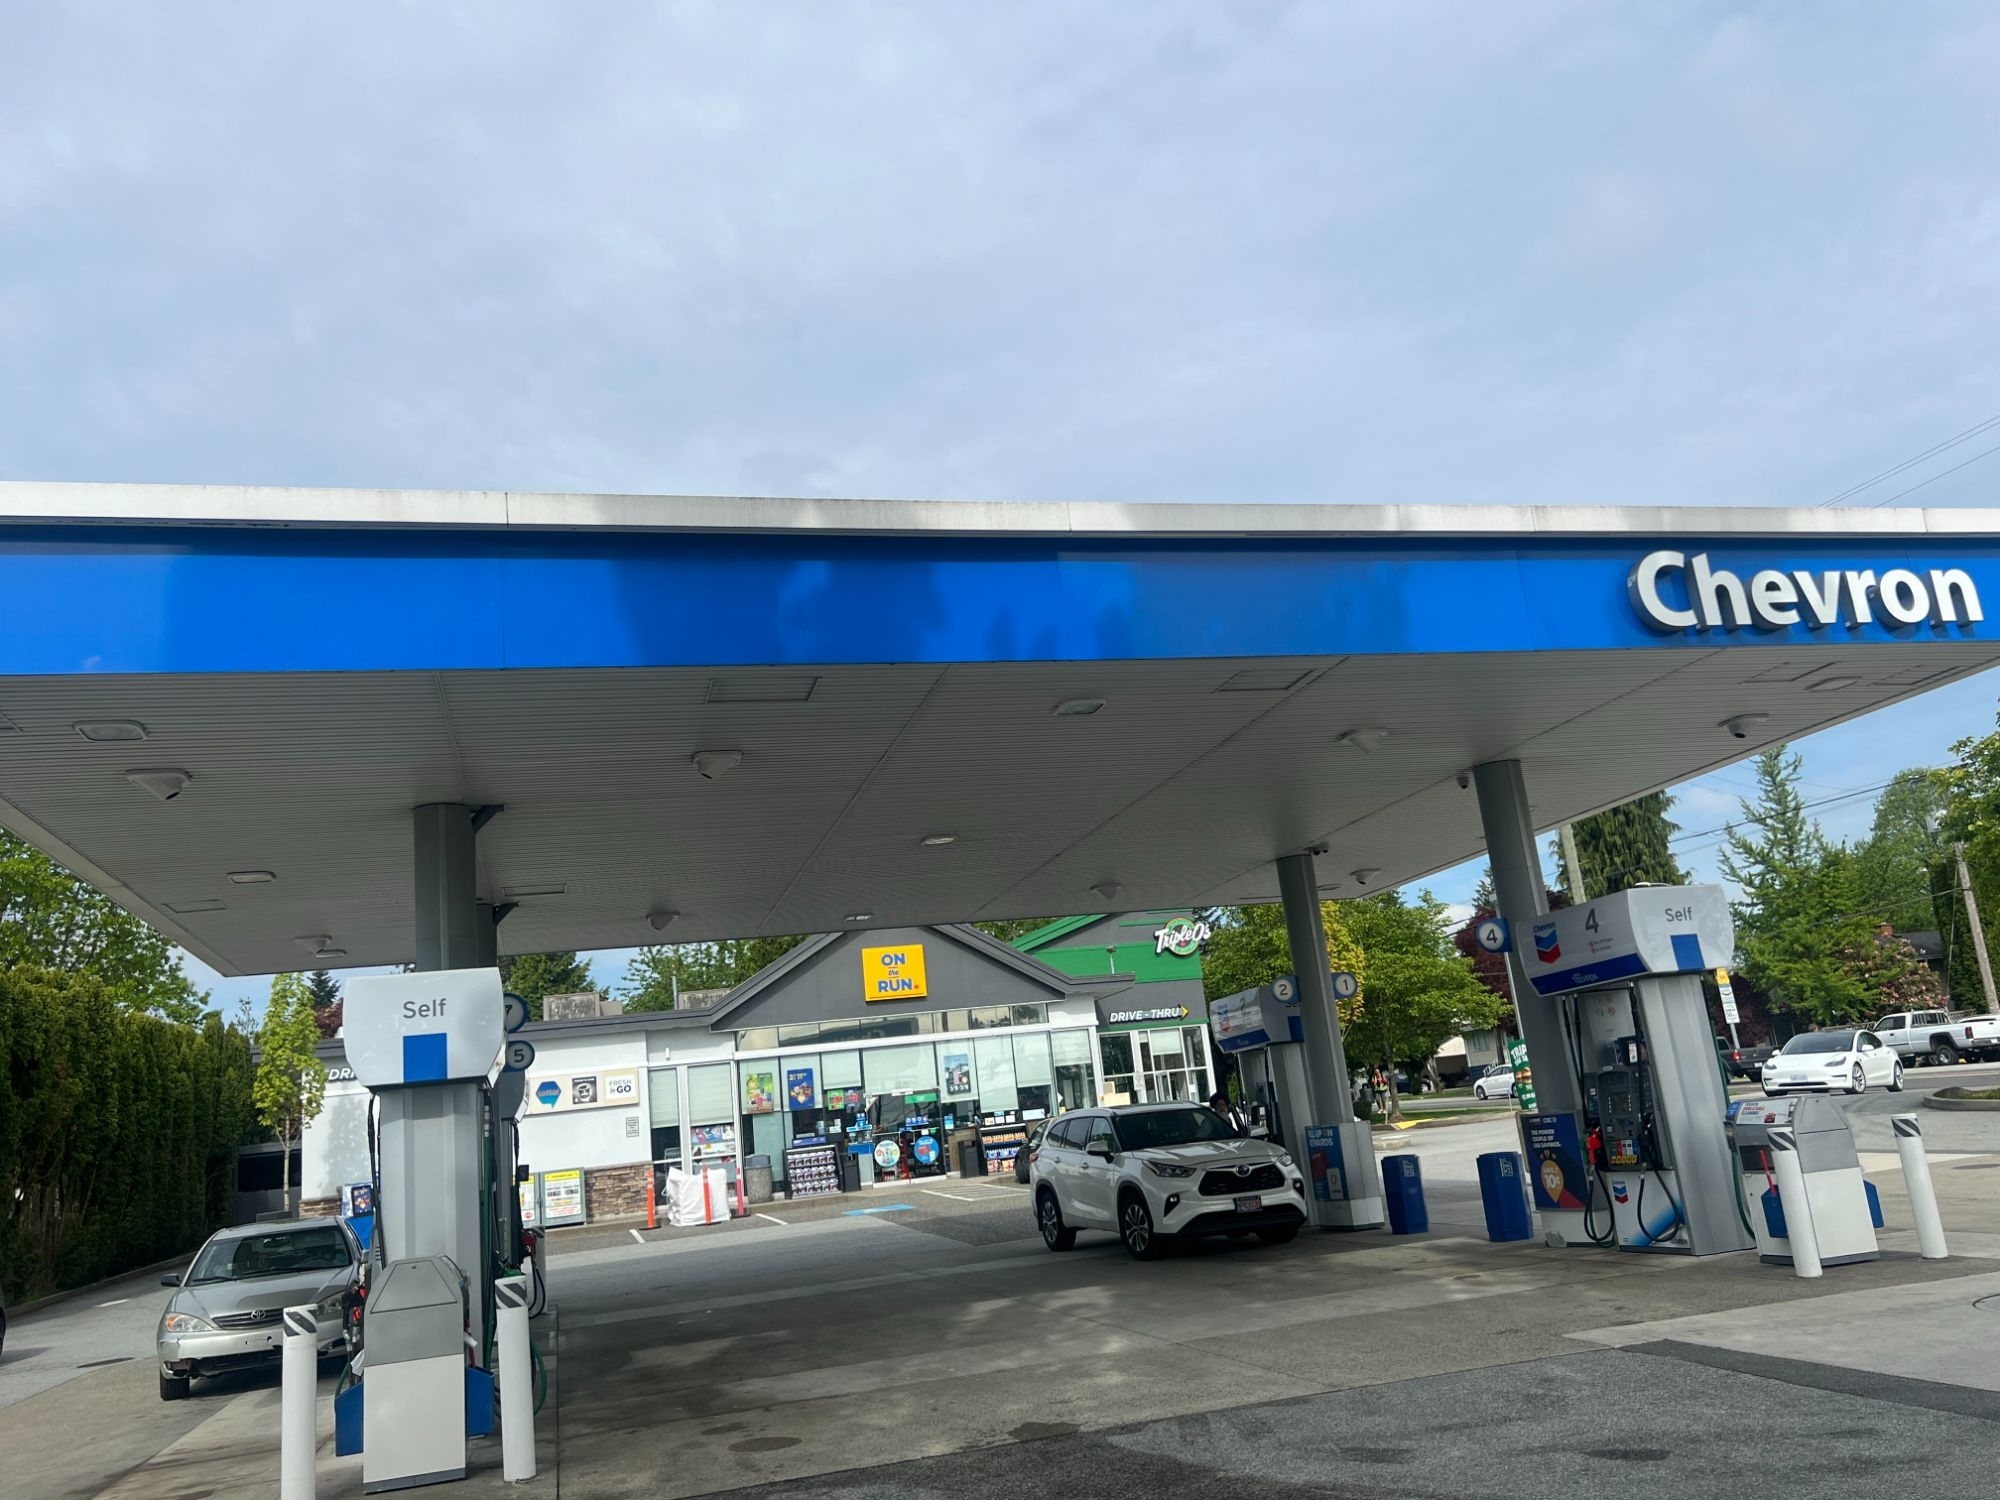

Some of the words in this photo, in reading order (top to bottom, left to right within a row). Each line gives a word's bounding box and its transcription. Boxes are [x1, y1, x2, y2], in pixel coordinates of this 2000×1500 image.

[1636, 550, 1984, 628] Chevron
[1585, 908, 1600, 934] 4
[1664, 906, 1693, 922] Self
[1485, 928, 1498, 944] 4
[881, 953, 905, 966] ON
[878, 978, 913, 992] RUN
[1278, 983, 1289, 996] 2
[1343, 979, 1349, 991] 1
[403, 998, 447, 1019] Self
[513, 1049, 525, 1063] 5
[609, 1079, 632, 1087] FRESH
[616, 1085, 632, 1094] GO
